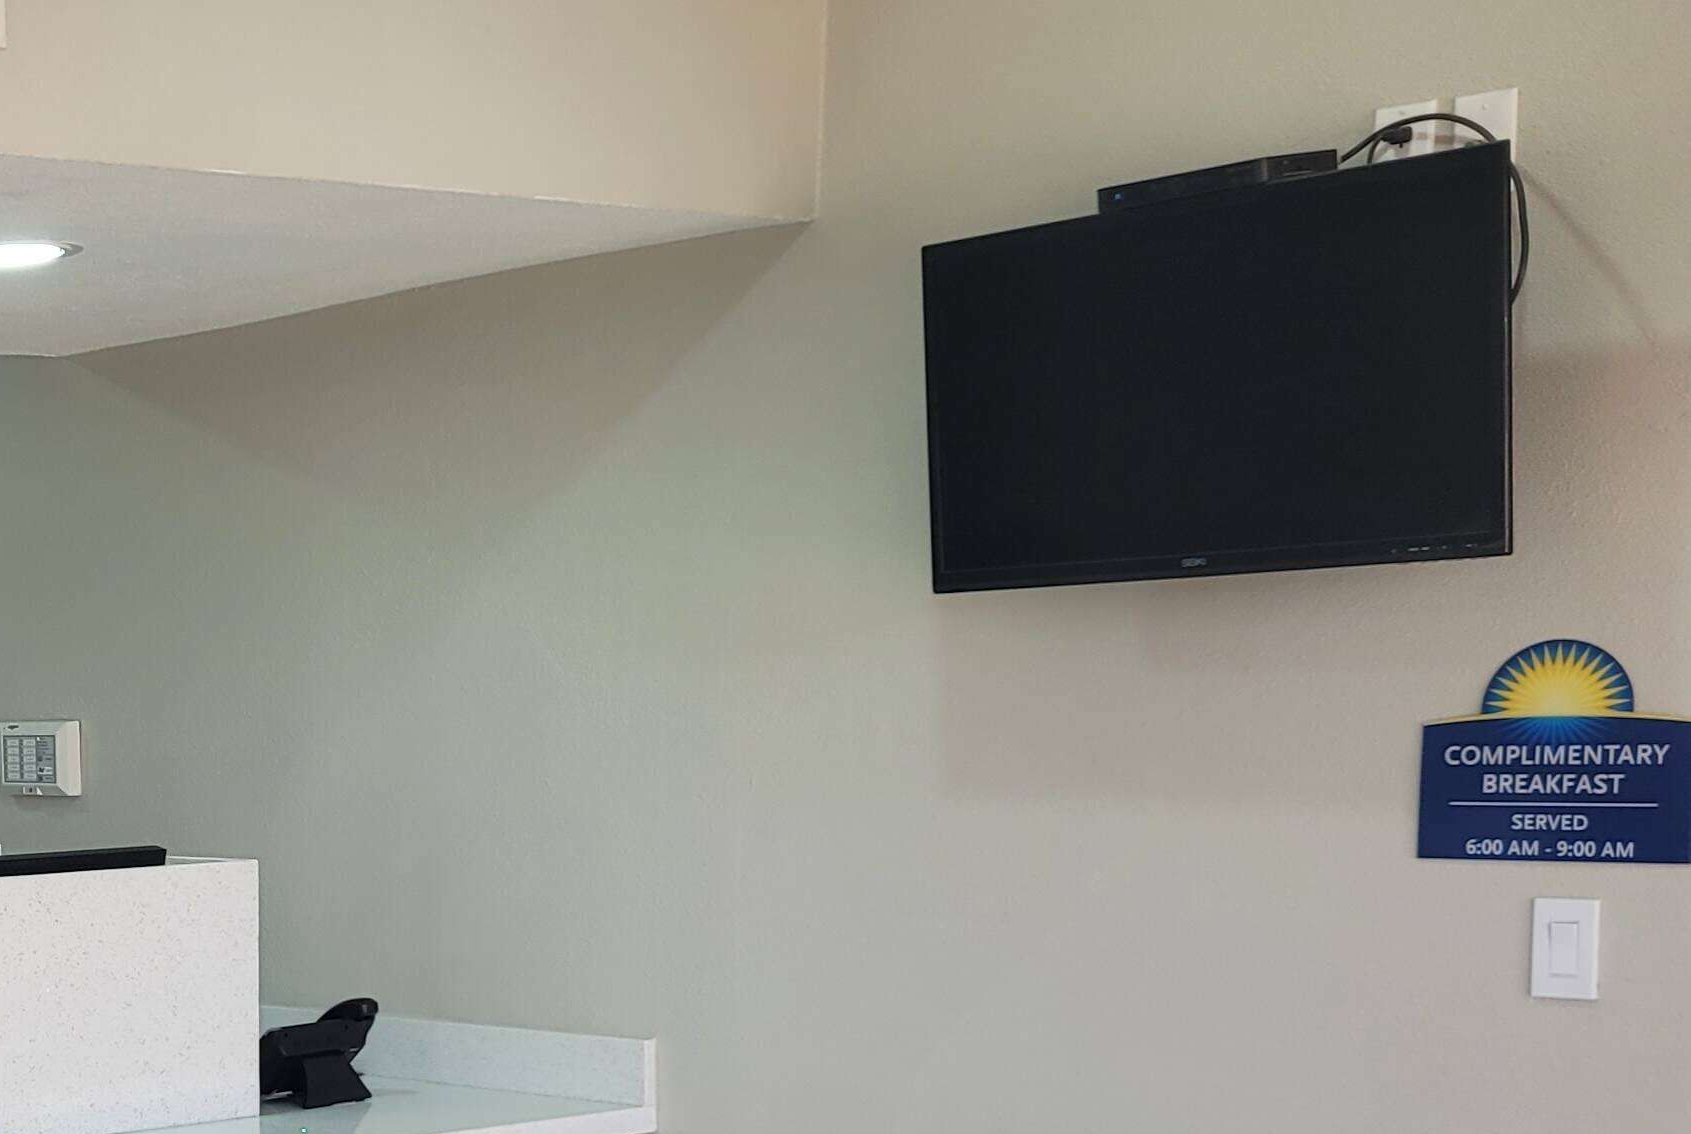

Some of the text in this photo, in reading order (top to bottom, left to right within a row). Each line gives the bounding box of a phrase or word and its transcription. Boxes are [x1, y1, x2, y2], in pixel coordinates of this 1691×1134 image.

[1444, 744, 1671, 766] COMPLIMENTARY
[1482, 773, 1625, 795] BREAKFAST
[1511, 814, 1589, 831] SERVED
[1465, 838, 1503, 855] 6:00
[1508, 841, 1539, 856] AM
[1556, 841, 1596, 857] 9:00
[1601, 842, 1634, 858] AM
